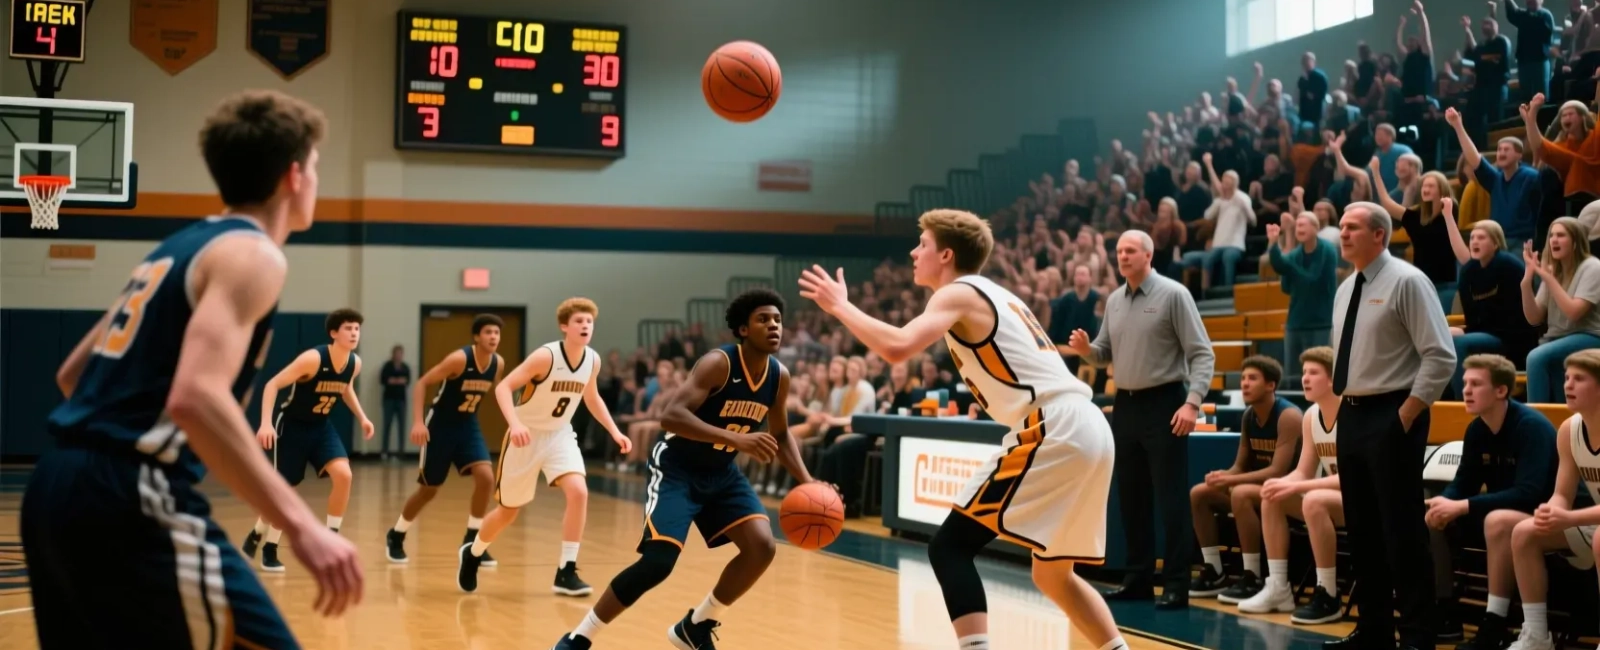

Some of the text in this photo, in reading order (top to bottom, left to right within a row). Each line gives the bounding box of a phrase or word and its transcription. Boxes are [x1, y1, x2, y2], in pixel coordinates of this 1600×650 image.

[36, 26, 57, 55] 4
[429, 45, 459, 78] 10
[583, 54, 620, 88] 30
[417, 106, 440, 138] 3
[601, 115, 620, 147] 9
[551, 397, 571, 418] 8
